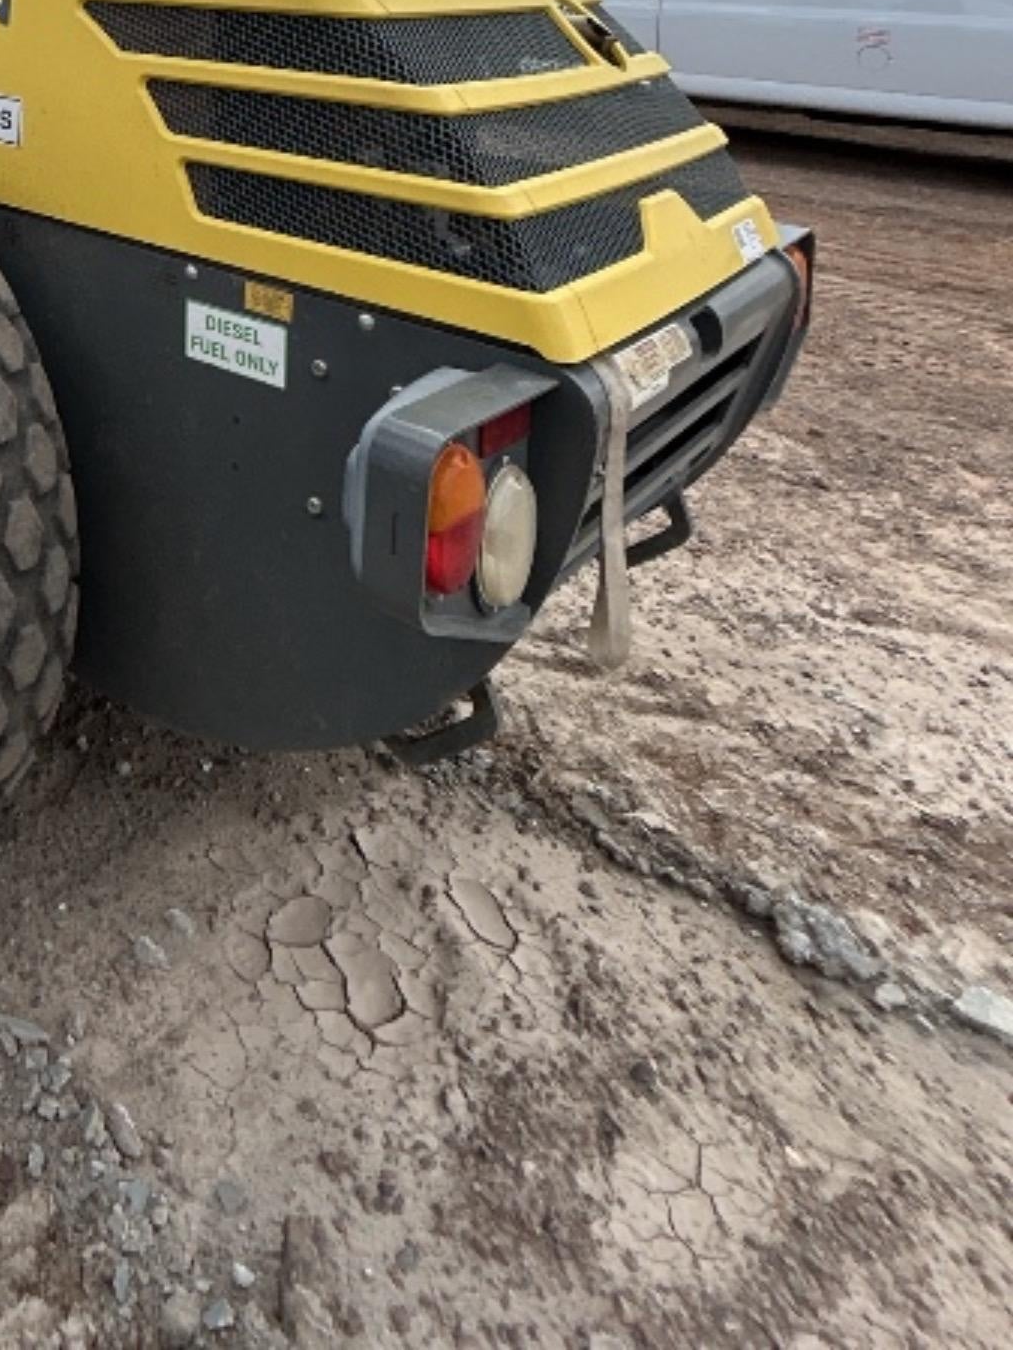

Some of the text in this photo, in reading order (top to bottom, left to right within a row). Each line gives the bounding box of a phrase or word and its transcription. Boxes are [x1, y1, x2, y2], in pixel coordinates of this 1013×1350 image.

[205, 314, 261, 346] DIESEL
[190, 335, 279, 376] FUEL ONLY
